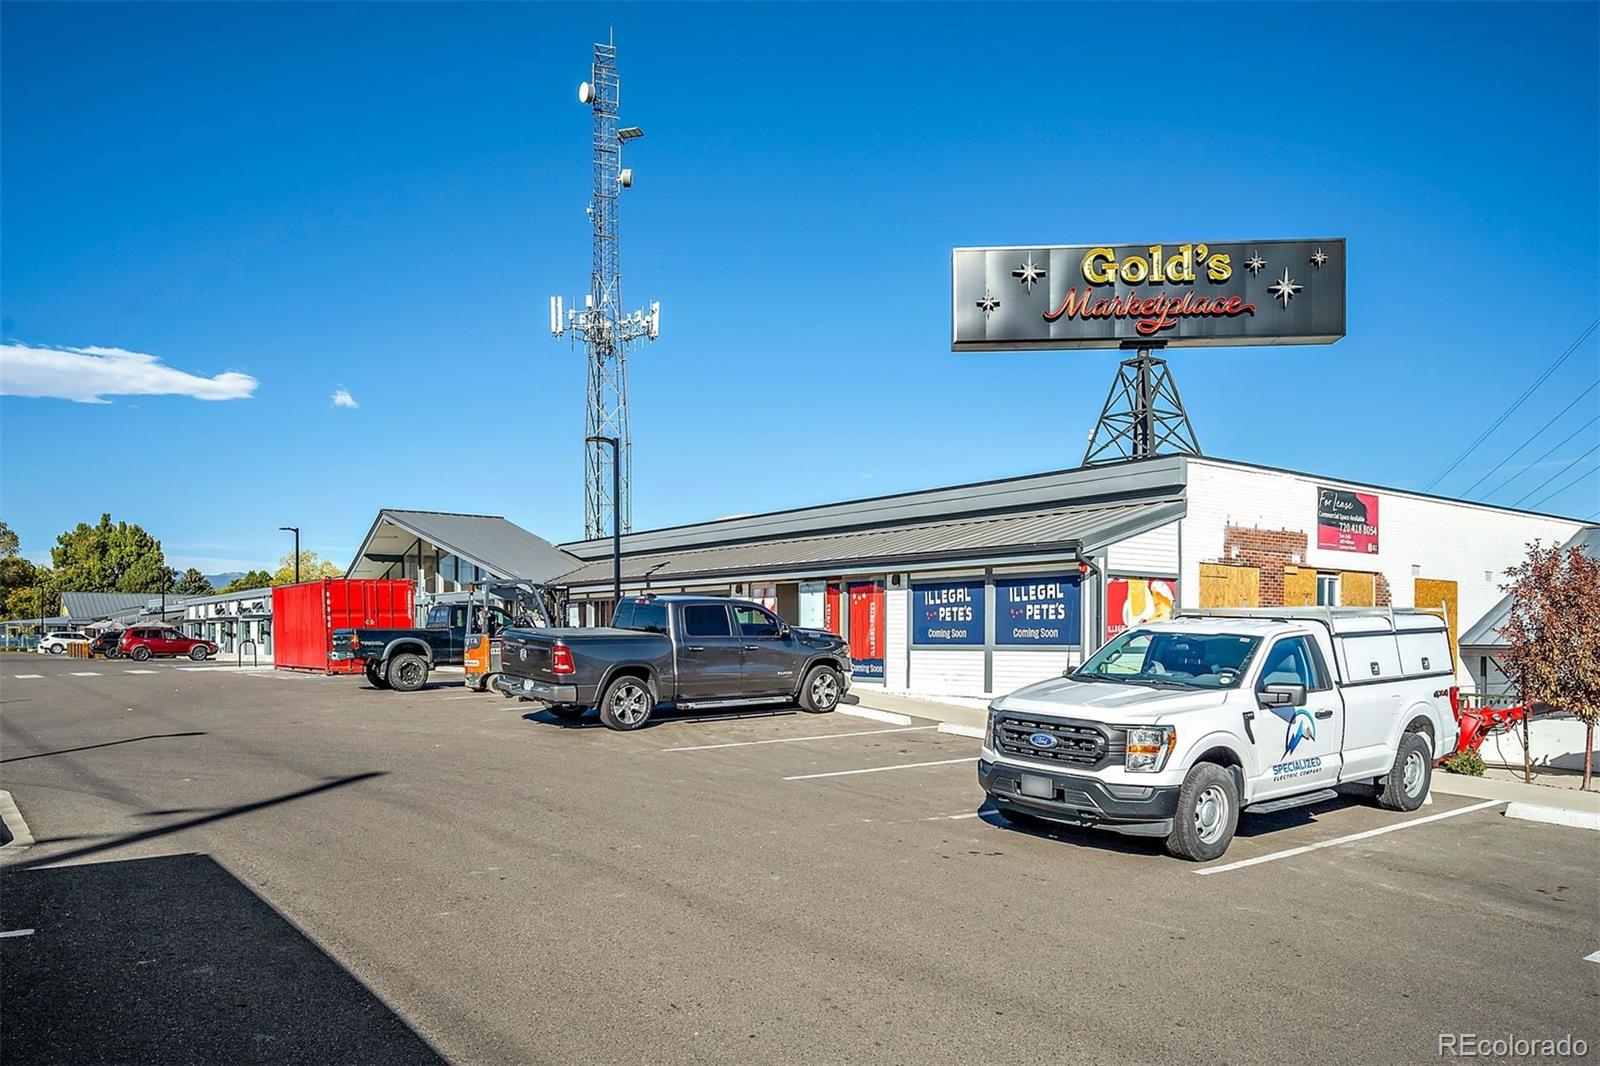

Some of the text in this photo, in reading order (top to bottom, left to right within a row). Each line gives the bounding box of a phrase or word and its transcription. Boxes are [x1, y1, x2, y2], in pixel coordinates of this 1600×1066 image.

[1081, 244, 1233, 284] Gold's
[1043, 287, 1256, 334] Marketplace
[1319, 490, 1354, 511] For Lease
[1339, 522, 1351, 533] 720
[925, 587, 971, 605] ILLEGAL
[1009, 583, 1064, 602] ILLEGAL
[939, 605, 972, 622] PETE'S
[1026, 602, 1065, 620] PETE'S
[928, 628, 967, 639] Coming Soon
[1013, 627, 1059, 639] Coming Soon
[870, 664, 883, 673] Soon
[1272, 757, 1322, 775] SPECIALIZED
[1272, 767, 1322, 782] ELECTRIC COMPANY
